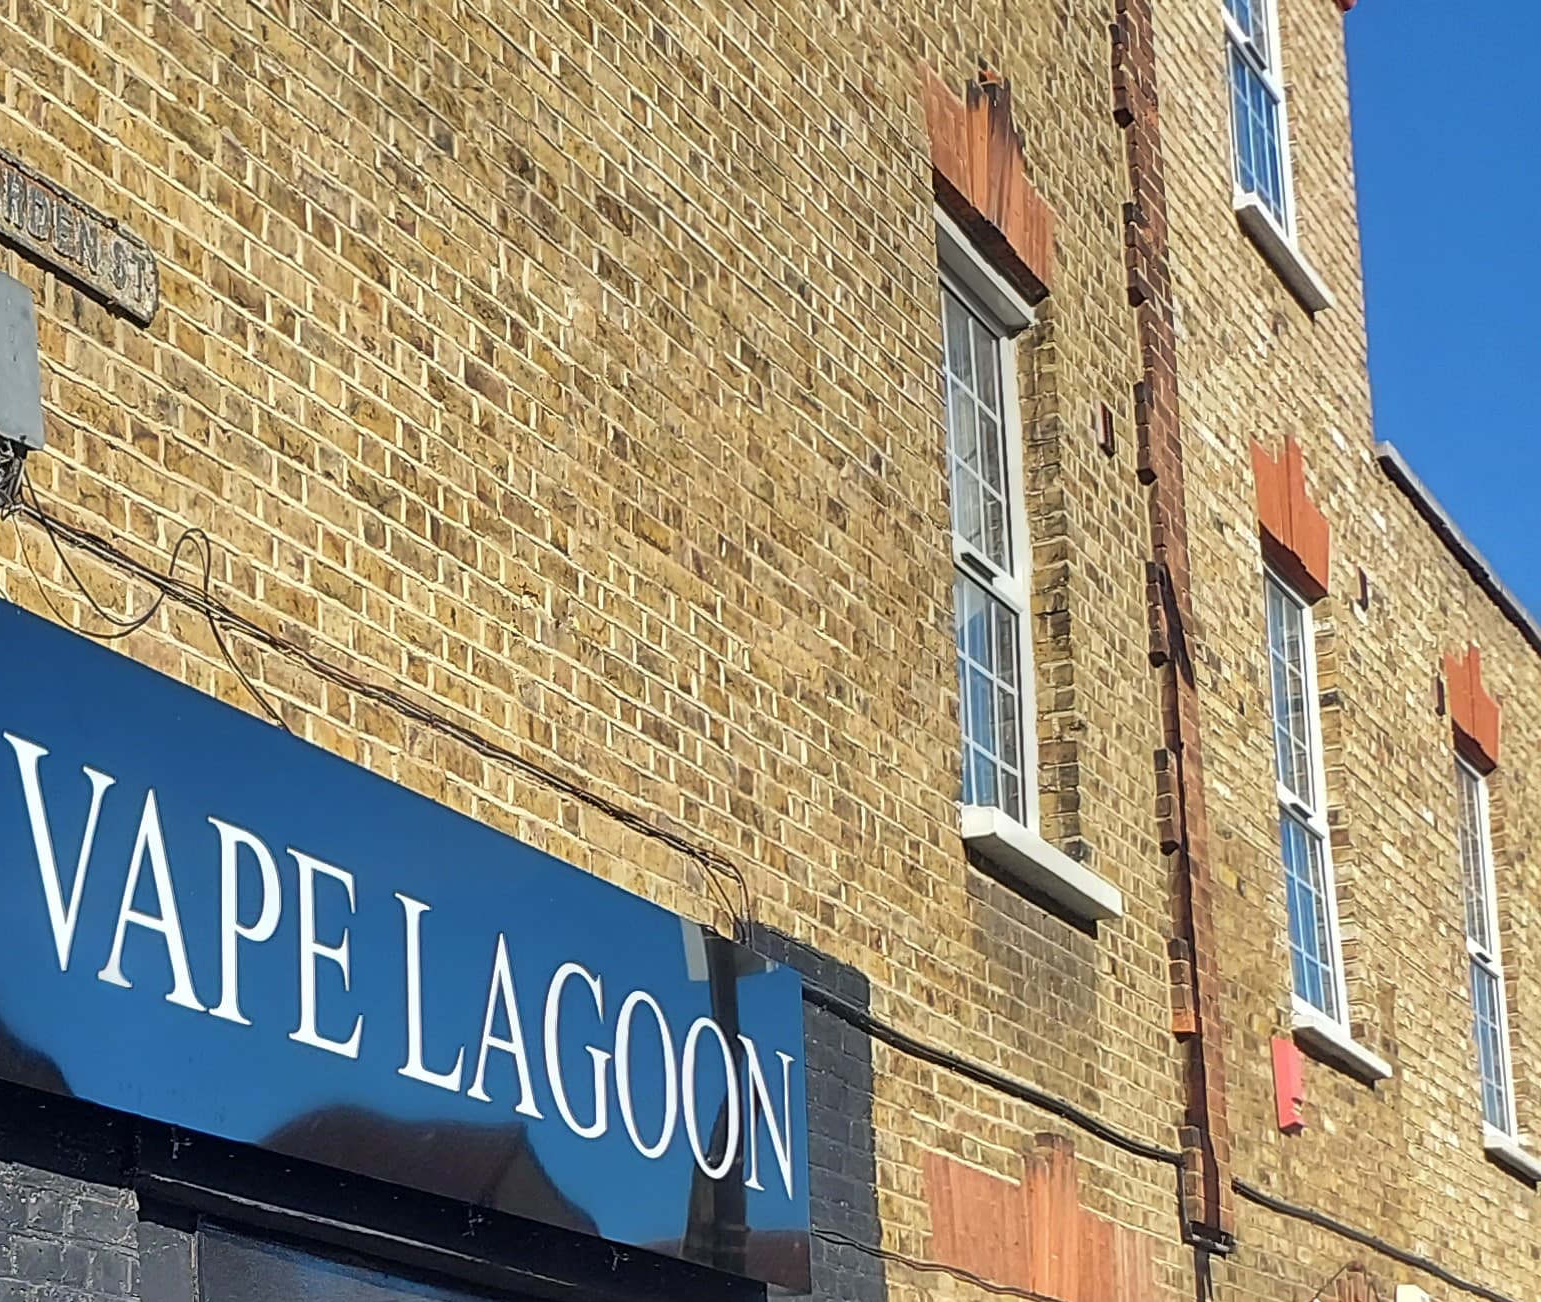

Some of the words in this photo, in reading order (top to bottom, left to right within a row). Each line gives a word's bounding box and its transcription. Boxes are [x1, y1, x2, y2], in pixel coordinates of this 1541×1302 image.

[109, 240, 152, 302] ST
[3, 730, 364, 1060] VAPE
[394, 891, 795, 1200] LAGOON
